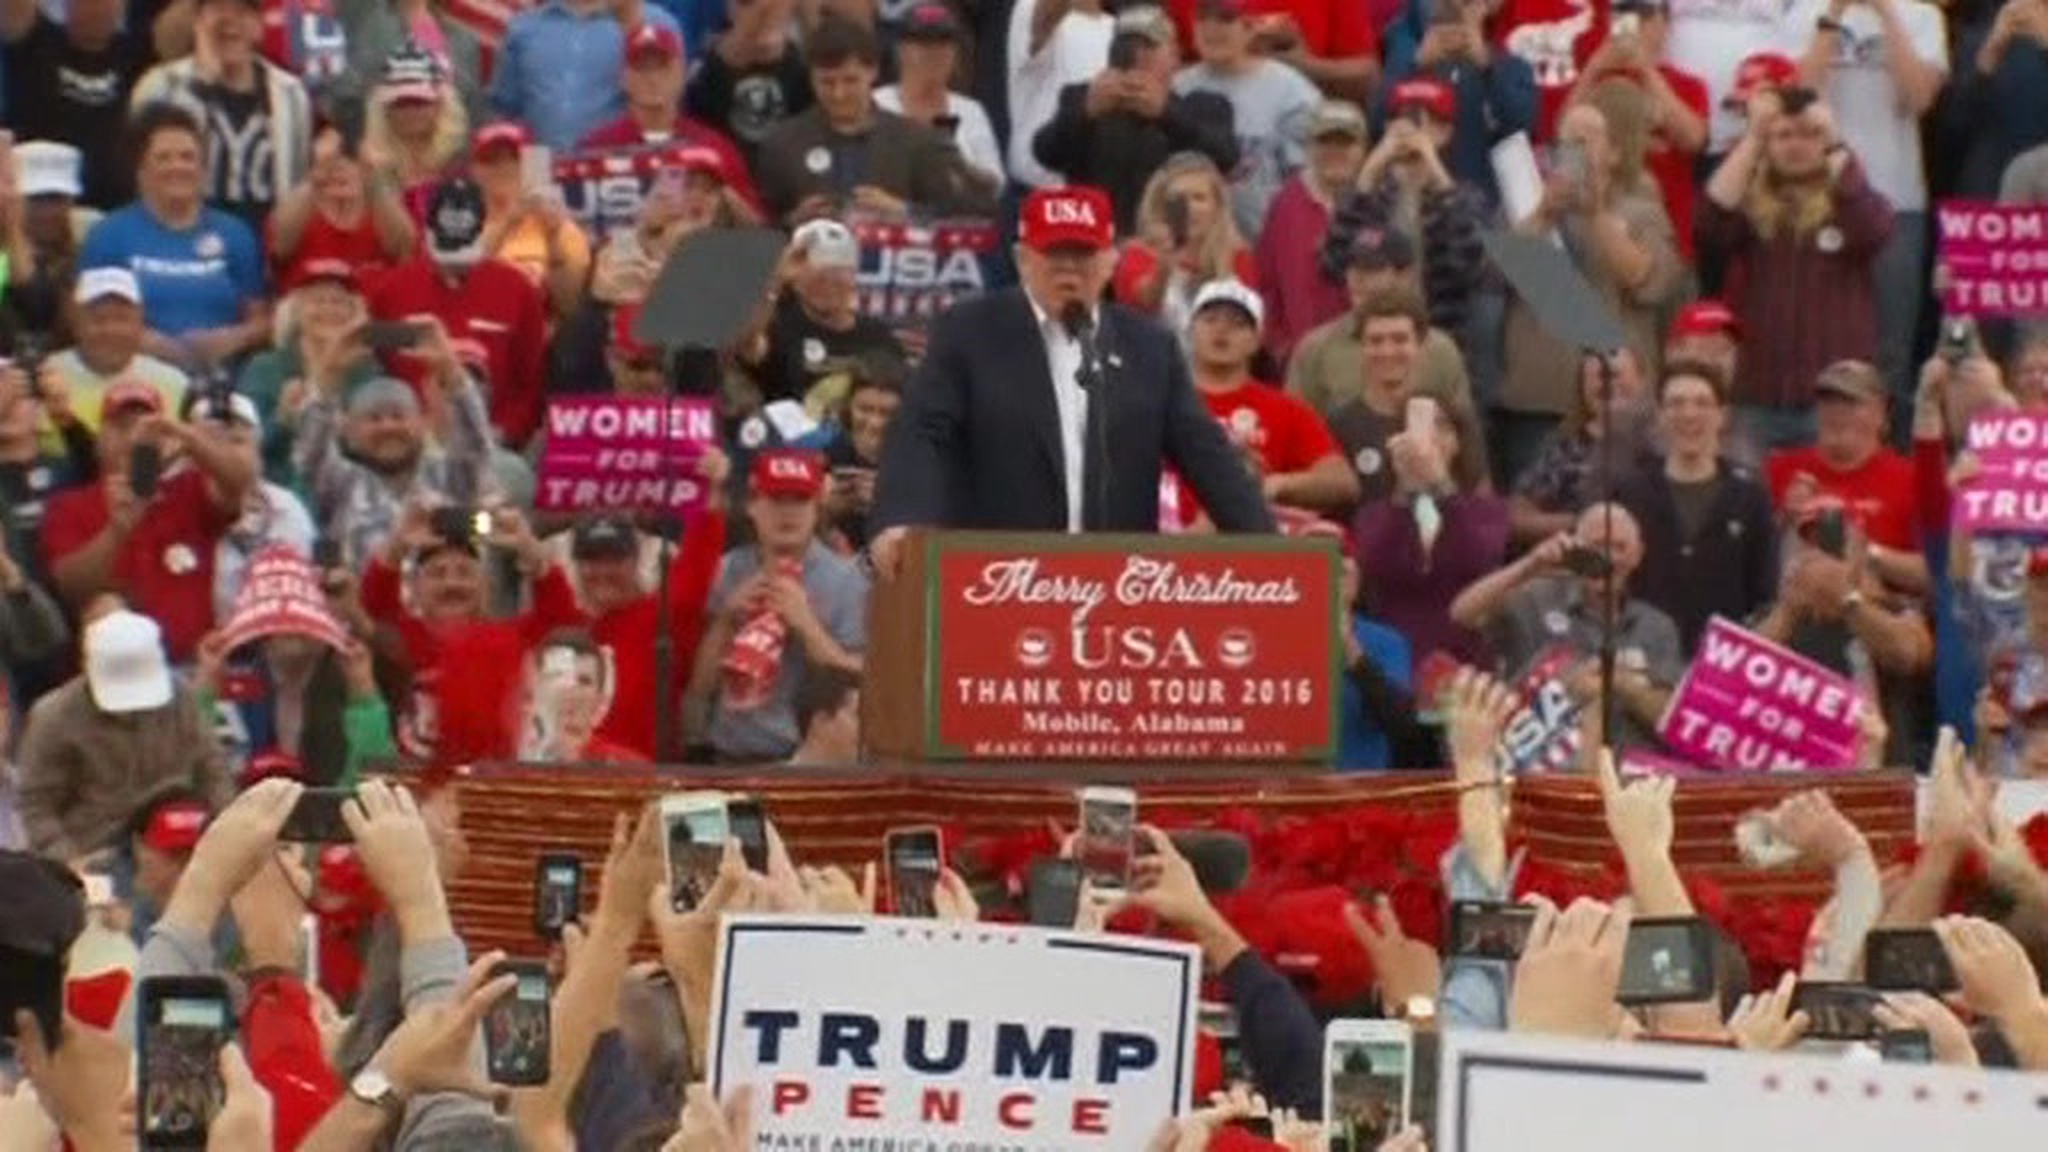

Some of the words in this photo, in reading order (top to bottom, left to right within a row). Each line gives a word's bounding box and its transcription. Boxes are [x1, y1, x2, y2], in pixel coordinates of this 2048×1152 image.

[1044, 199, 1095, 226] USA
[1953, 280, 2048, 306] TRU
[549, 404, 714, 441] WOMEN
[1969, 417, 2048, 448] WO
[595, 451, 661, 471] FOR
[545, 478, 700, 506] TRUMP
[964, 557, 1103, 625] Merry
[1115, 555, 1301, 607] Christmas
[1071, 625, 1203, 669] USA
[958, 678, 1062, 705] THANK
[1078, 678, 1134, 705] YOU
[1148, 678, 1225, 705] TOUR
[1243, 678, 1313, 705] 2016
[1022, 712, 1121, 736] Mobile,
[1130, 711, 1246, 734] Alabama
[1738, 697, 1805, 741] FOR
[744, 1010, 1159, 1085] TRUMP
[772, 1081, 1111, 1135] PENCE
[756, 1131, 823, 1151] MAKE
[831, 1134, 937, 1152] AMERICA
